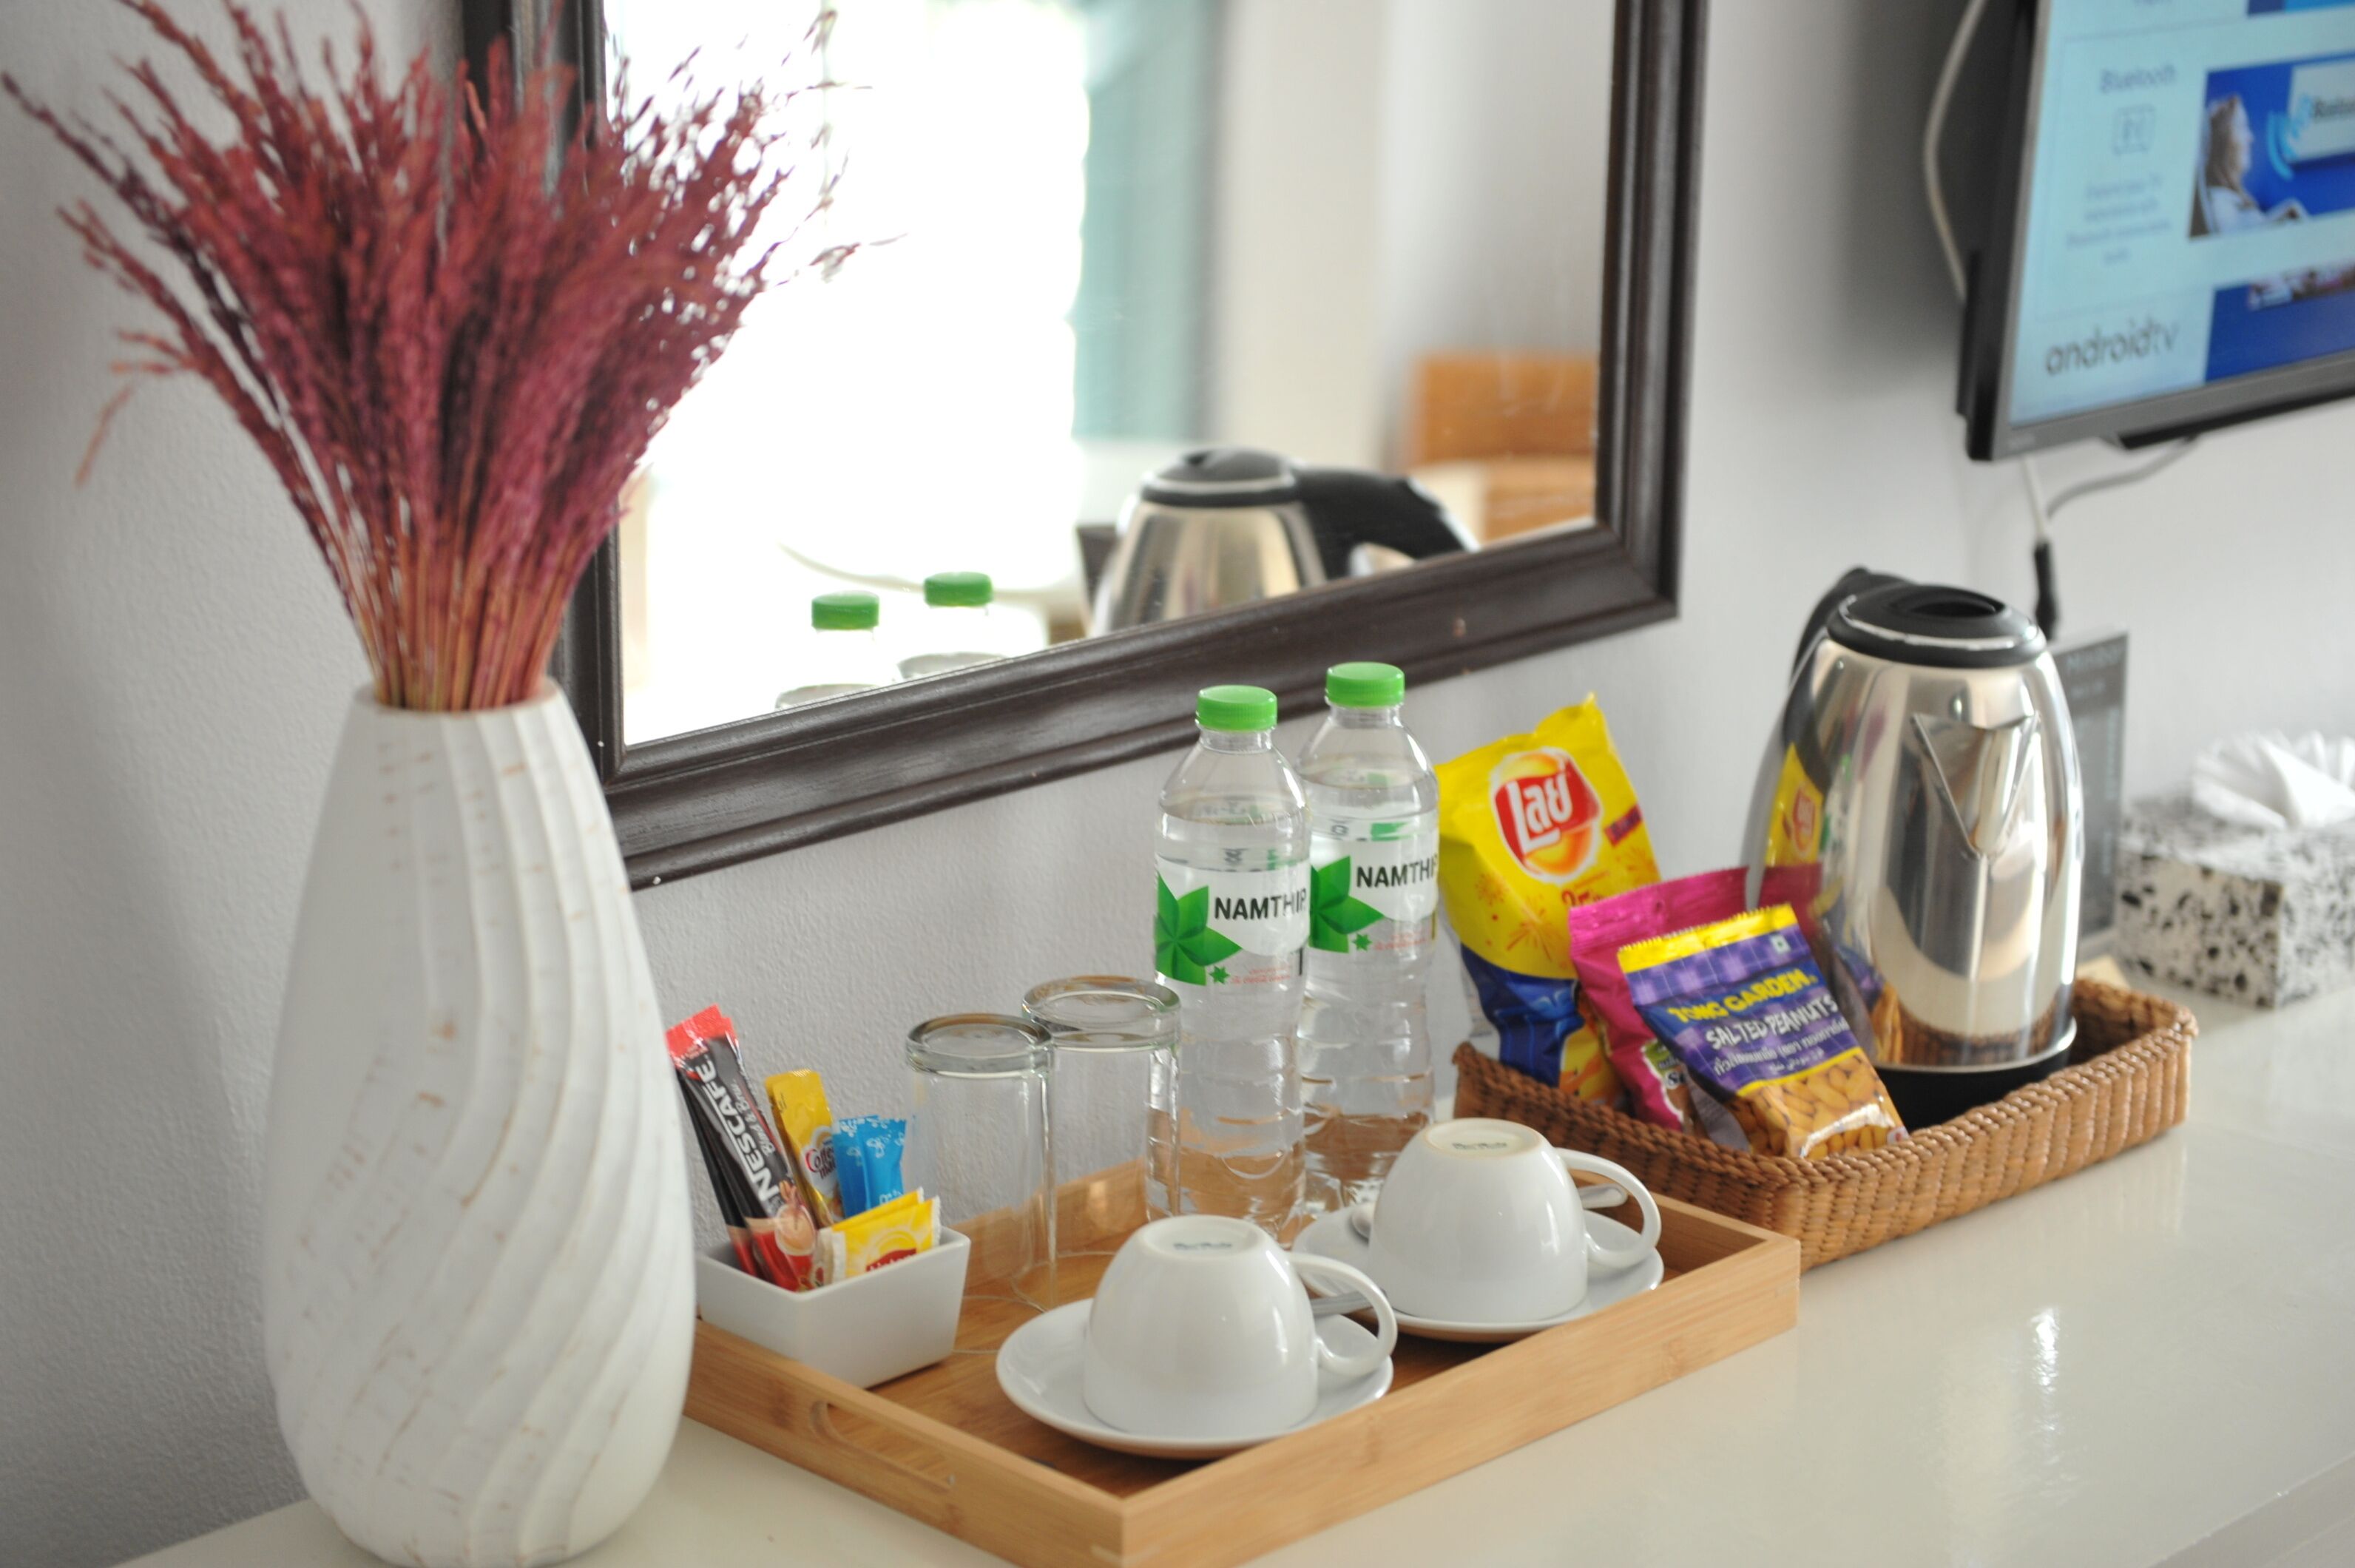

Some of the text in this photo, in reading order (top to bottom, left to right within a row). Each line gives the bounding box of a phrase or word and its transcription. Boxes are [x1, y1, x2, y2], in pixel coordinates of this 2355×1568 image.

[1723, 968, 1811, 1011] GARDEN
[1706, 993, 1839, 1050] SALTED PEANUTS
